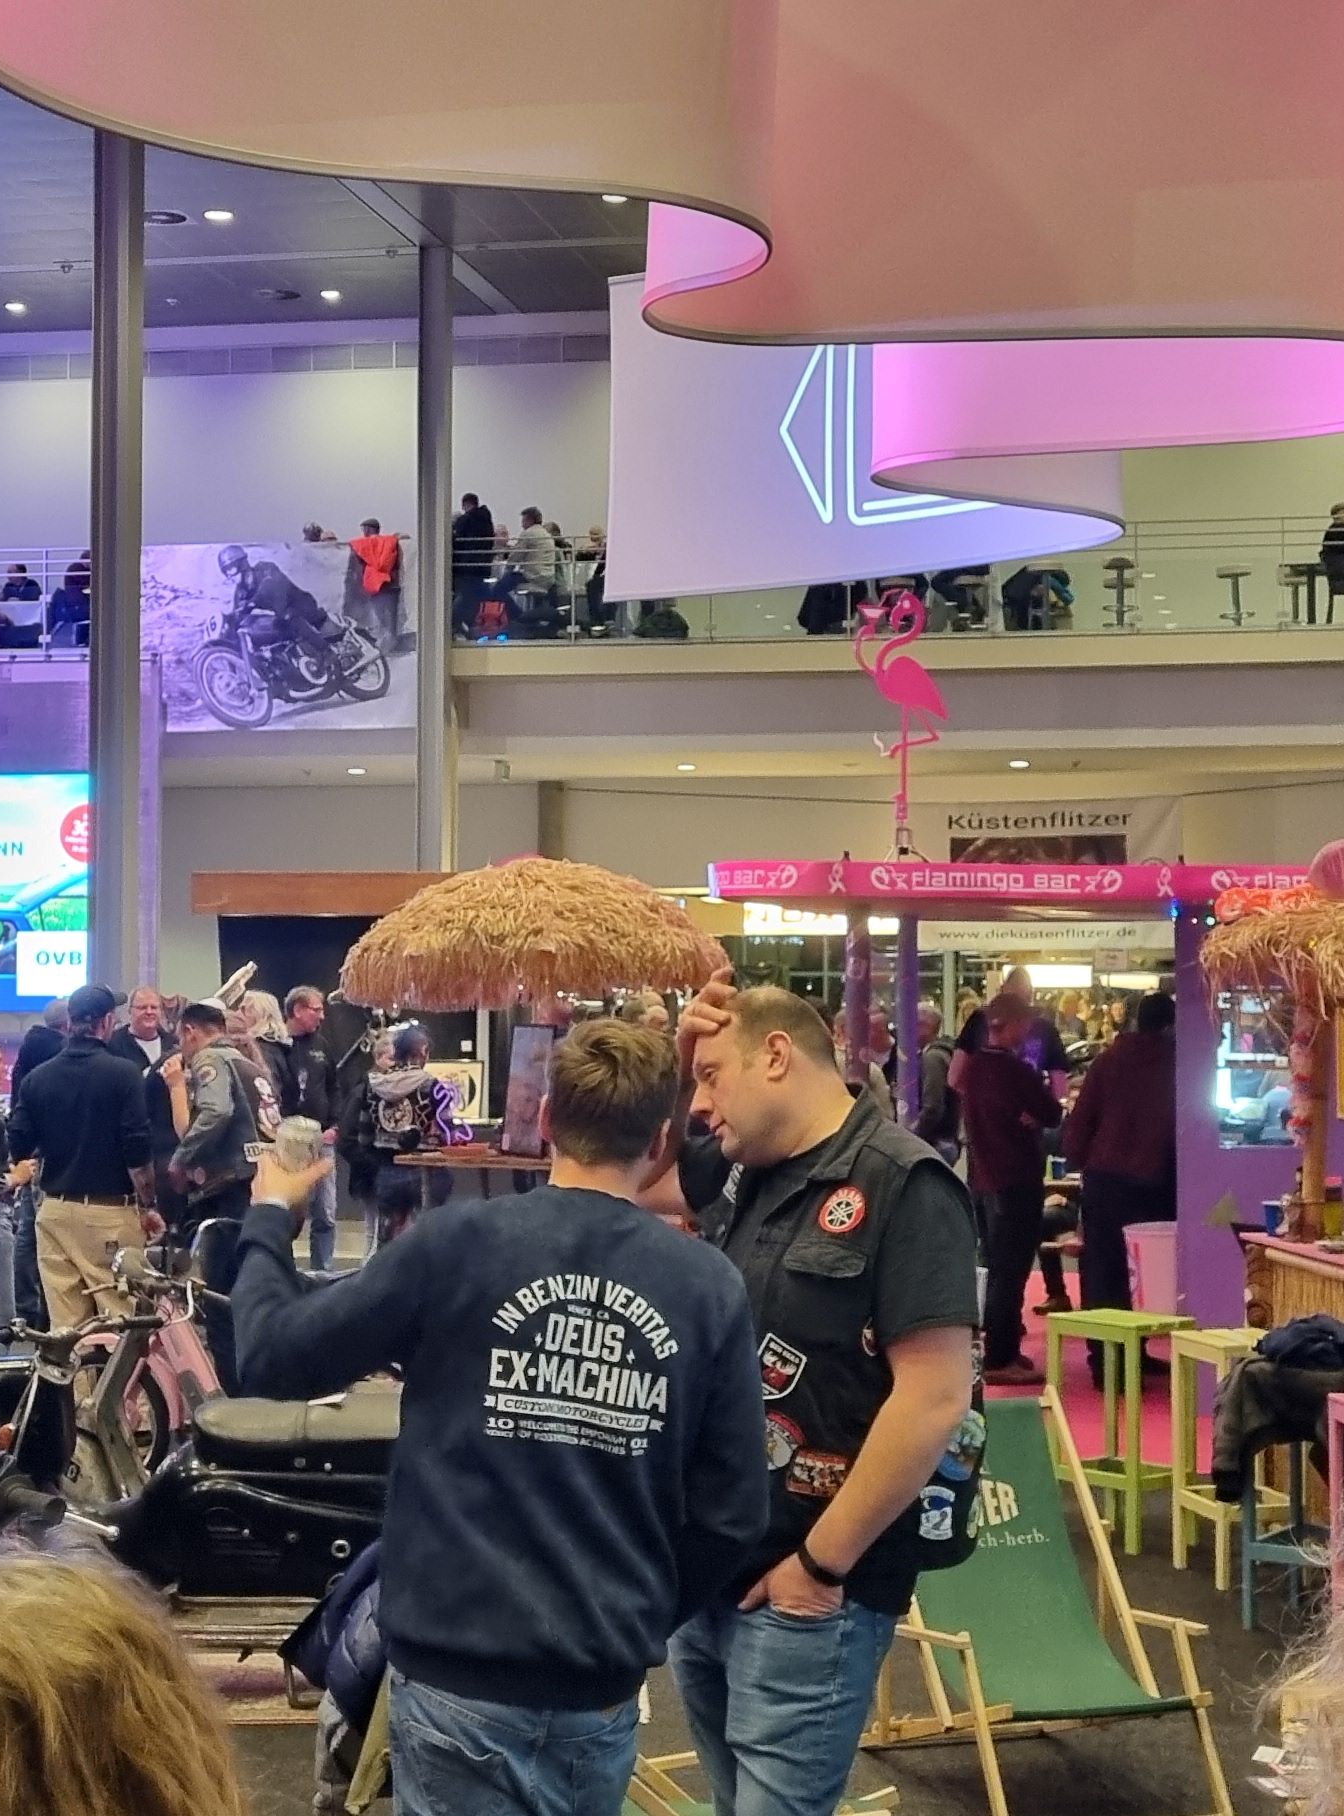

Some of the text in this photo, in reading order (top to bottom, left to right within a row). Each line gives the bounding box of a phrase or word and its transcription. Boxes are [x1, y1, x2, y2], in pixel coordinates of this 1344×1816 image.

[947, 809, 1133, 830] Küstenflitzer
[491, 1274, 679, 1361] IN BENZIN VERITAS
[544, 1312, 626, 1363] DEUS
[487, 1417, 515, 1429] 10
[976, 1527, 1051, 1548] ch-herb.
